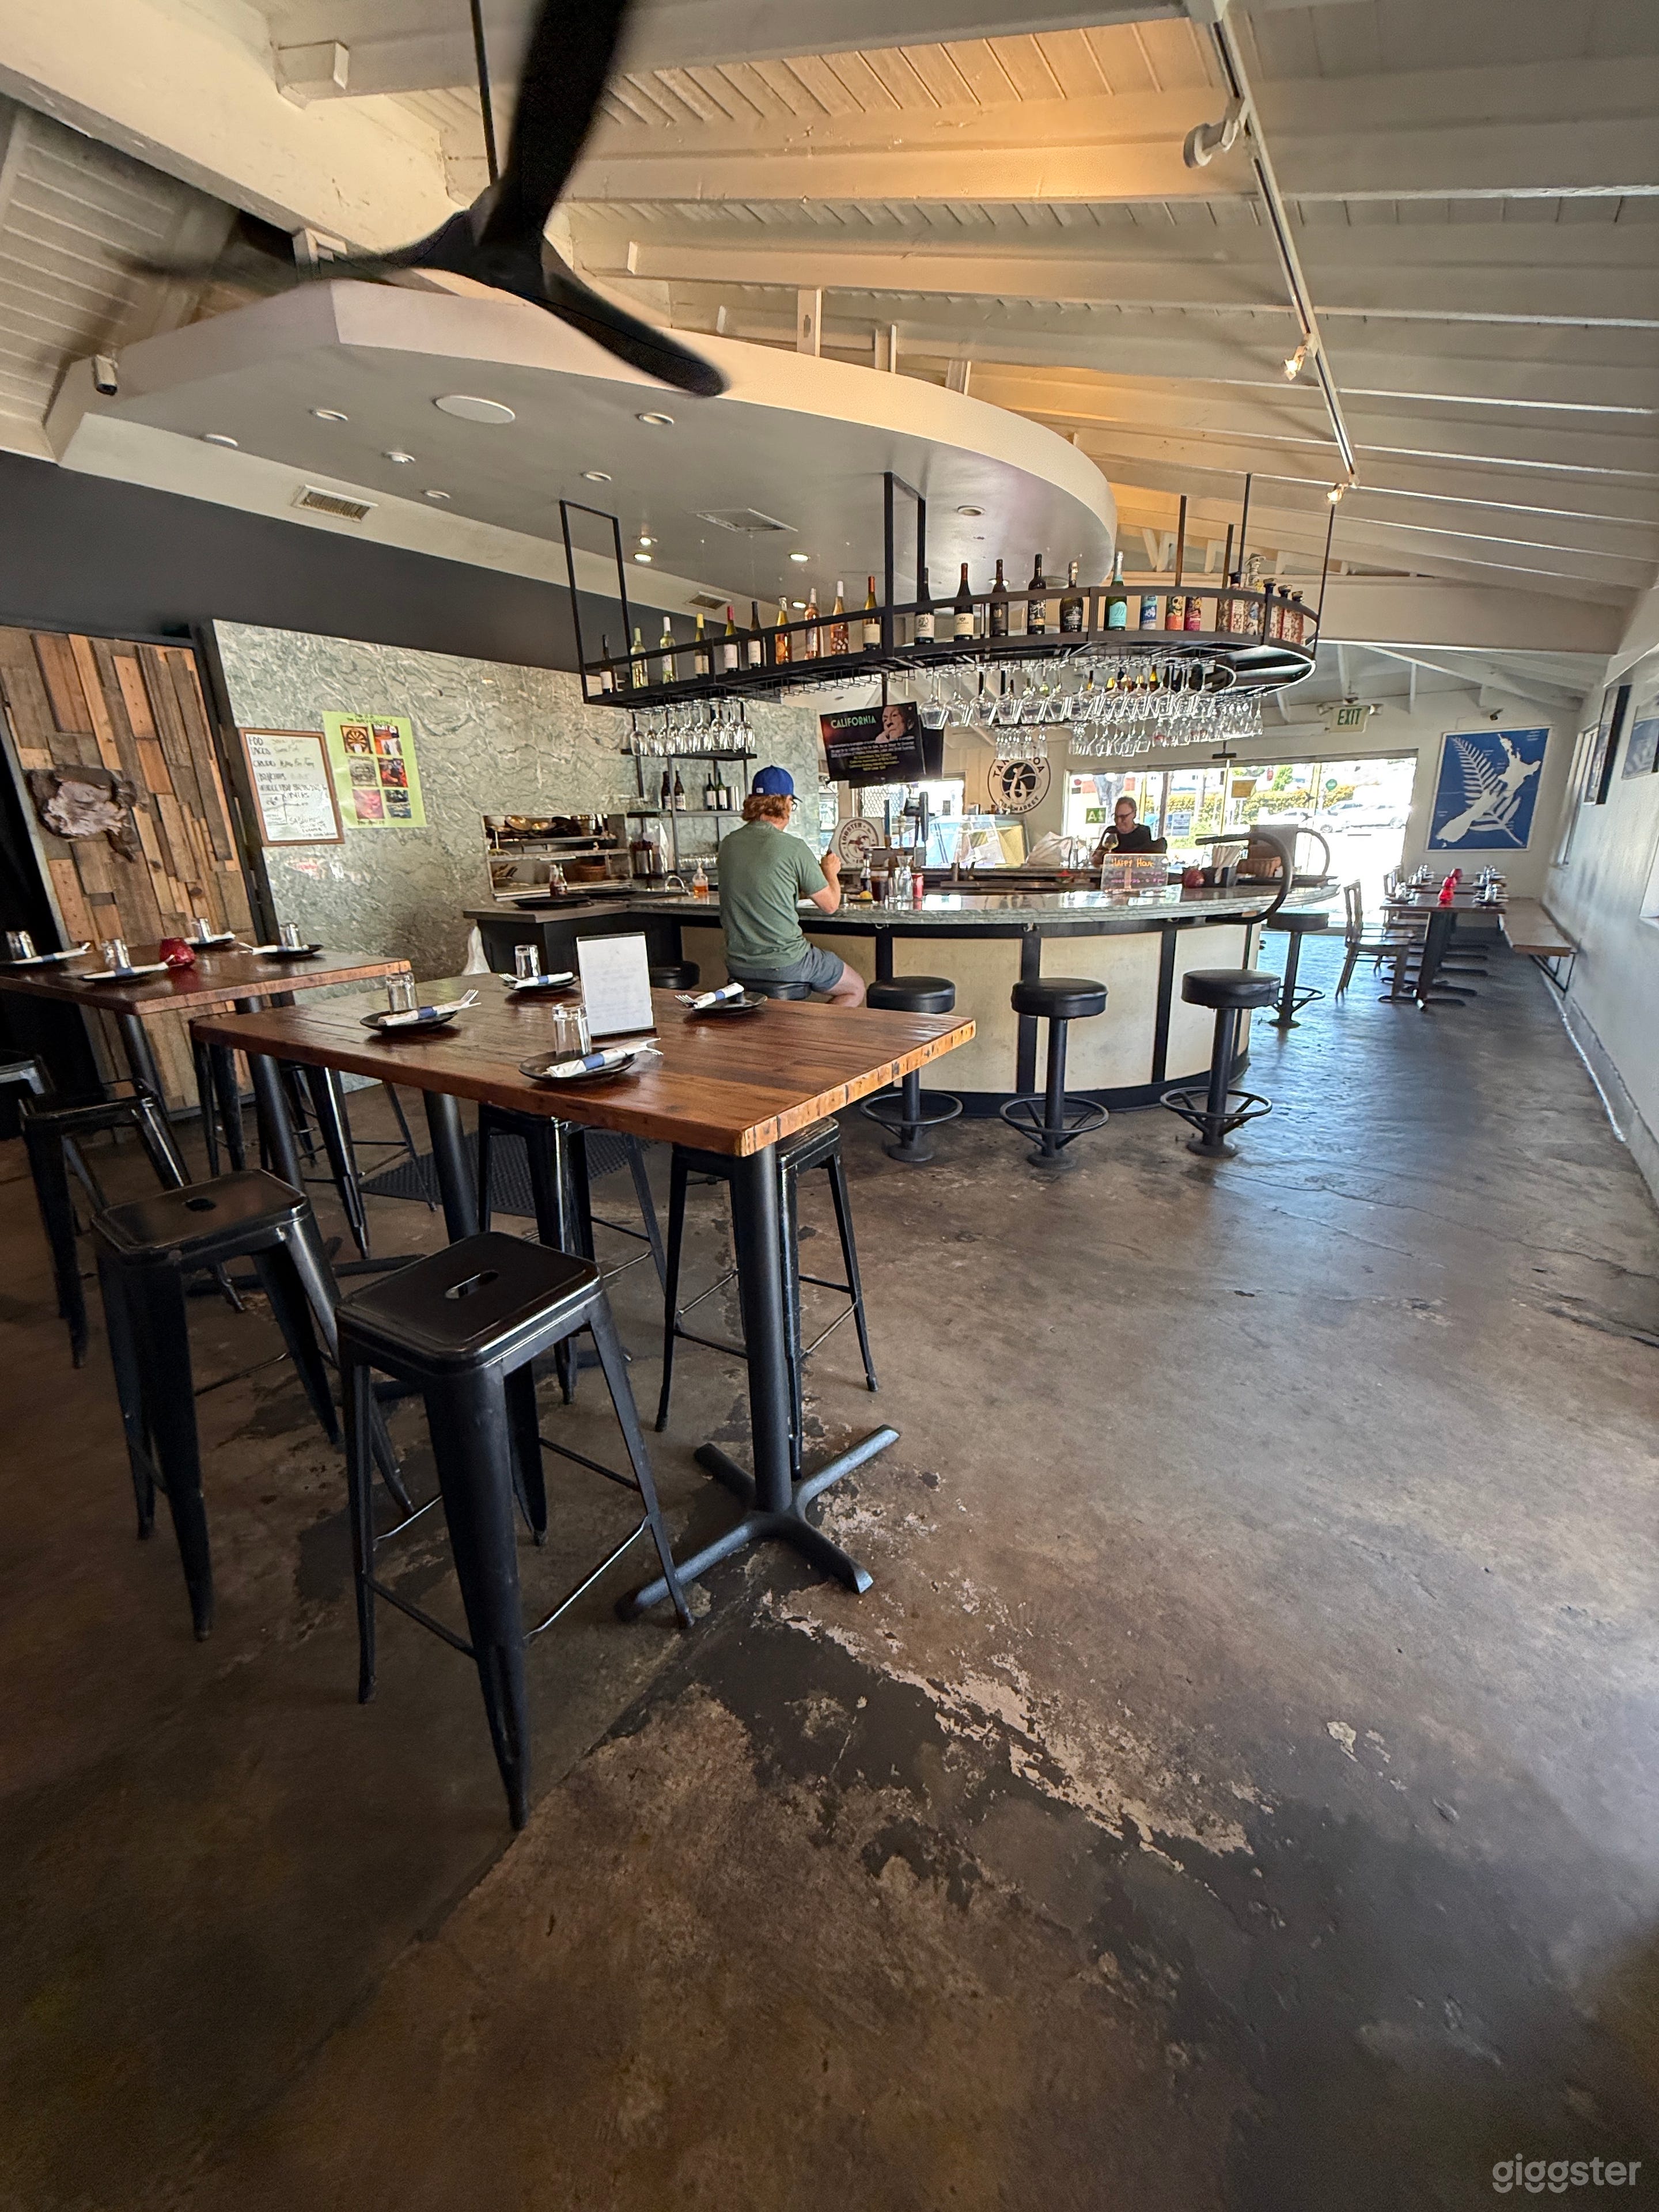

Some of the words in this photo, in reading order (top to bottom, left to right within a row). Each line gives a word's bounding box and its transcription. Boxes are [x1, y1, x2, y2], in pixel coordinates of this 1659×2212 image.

[831, 715, 877, 729] CALIFORNIA
[1337, 708, 1363, 725] EXIT
[1014, 796, 1039, 811] MARKET
[842, 822, 862, 845] LOBSTER
